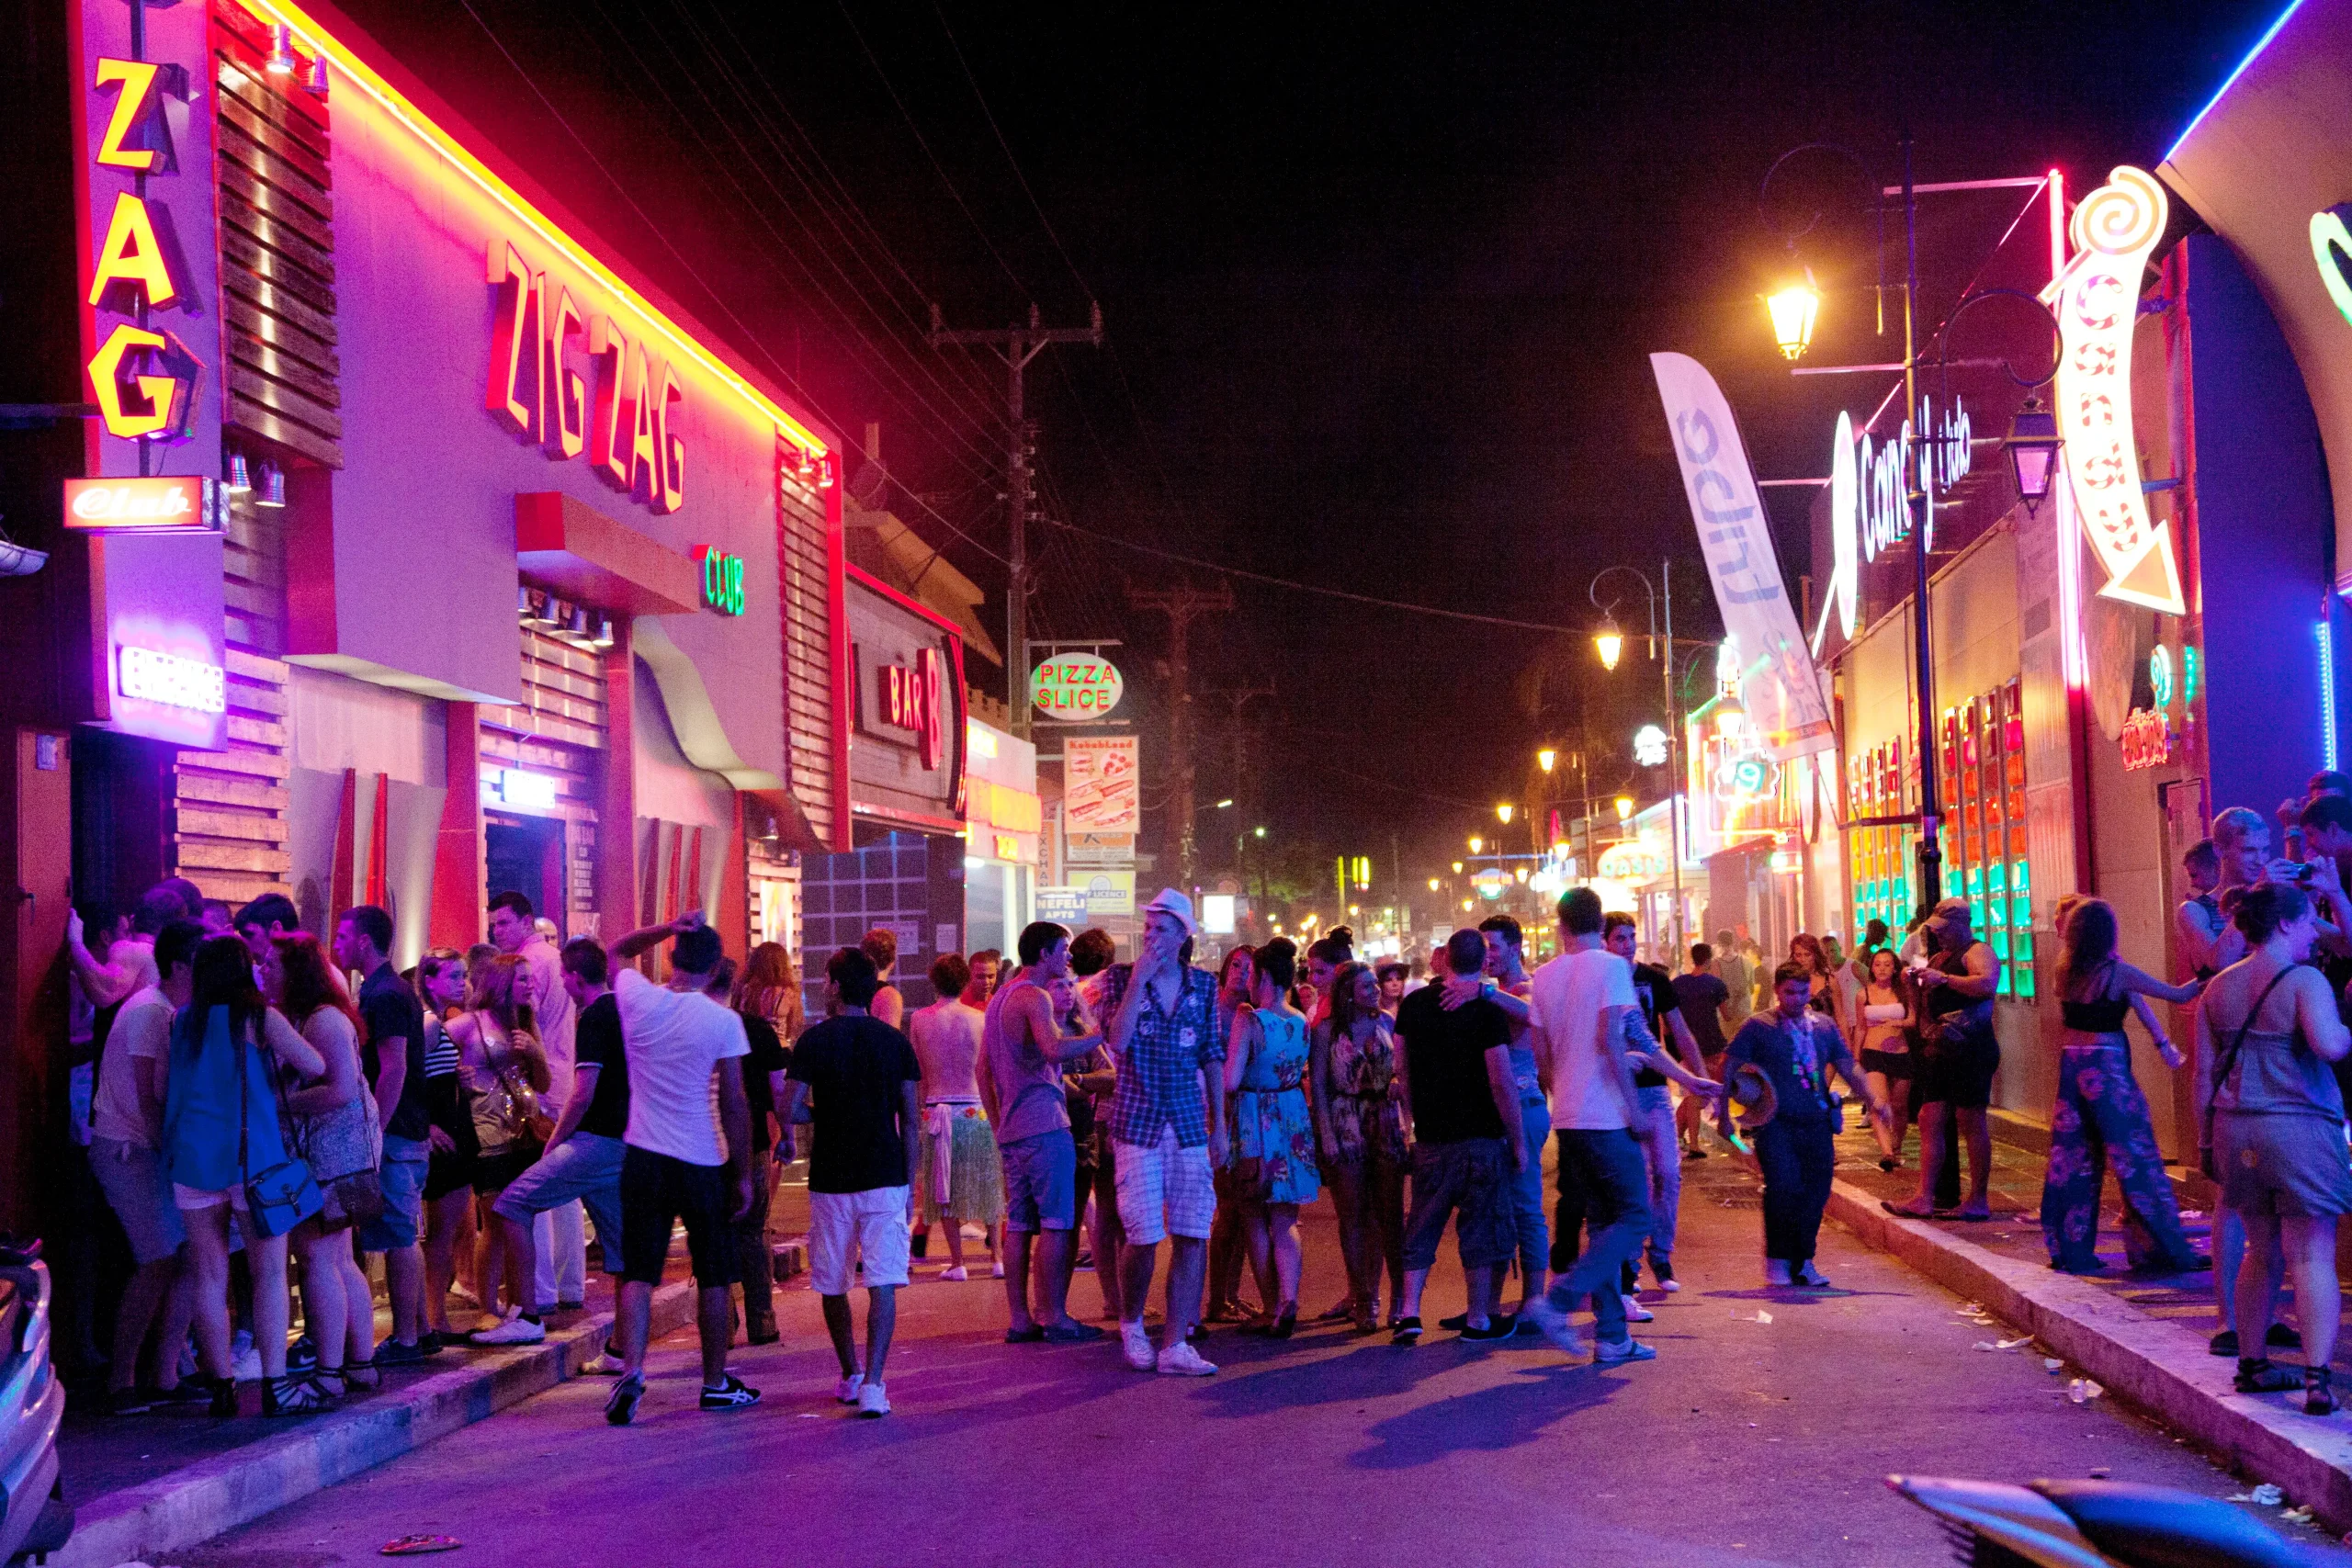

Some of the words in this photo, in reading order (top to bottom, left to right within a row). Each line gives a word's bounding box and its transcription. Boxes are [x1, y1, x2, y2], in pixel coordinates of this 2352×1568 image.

[87, 57, 177, 438] ZAG
[504, 240, 586, 459] ZIG
[606, 315, 685, 513] ZAG
[2075, 274, 2139, 552] Candy
[73, 486, 192, 519] Club
[705, 545, 745, 616] CLUB
[1039, 663, 1116, 684] PIZZA
[889, 664, 924, 732] BAR
[1036, 688, 1110, 710] SLICE
[1600, 857, 1667, 877] OASIS
[1036, 898, 1086, 909] NEFELI
[1045, 910, 1076, 919] APTS
